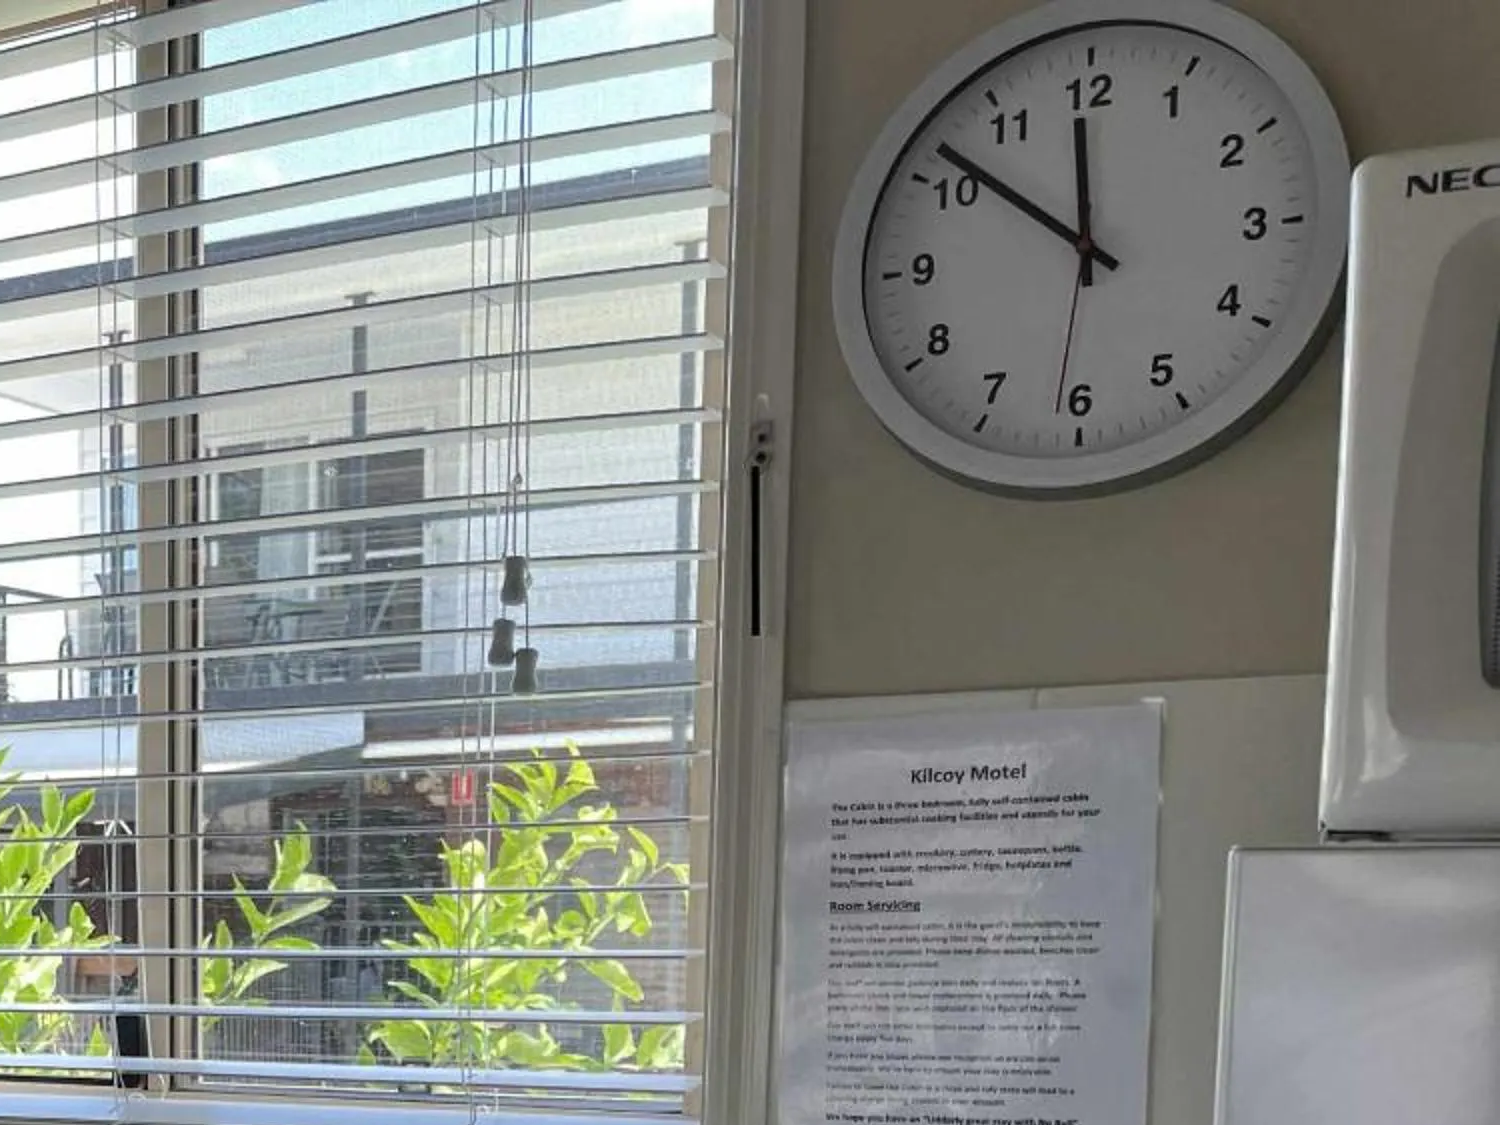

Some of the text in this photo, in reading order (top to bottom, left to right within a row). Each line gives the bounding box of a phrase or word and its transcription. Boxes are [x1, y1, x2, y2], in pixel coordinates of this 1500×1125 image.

[1065, 74, 1113, 111] 12
[1162, 86, 1179, 118] 1
[990, 109, 1028, 145] 11
[1220, 134, 1245, 168] 2
[932, 174, 979, 210] 10
[1406, 164, 1500, 198] NEC
[1243, 207, 1267, 241] 3
[912, 253, 935, 286] 9
[1217, 285, 1241, 317] 4
[927, 324, 950, 356] 8
[1150, 353, 1174, 387] 5
[983, 372, 1007, 405] 7
[1068, 384, 1093, 417] 6
[911, 762, 1027, 784] Kilcoy Motel
[828, 901, 865, 913] Room
